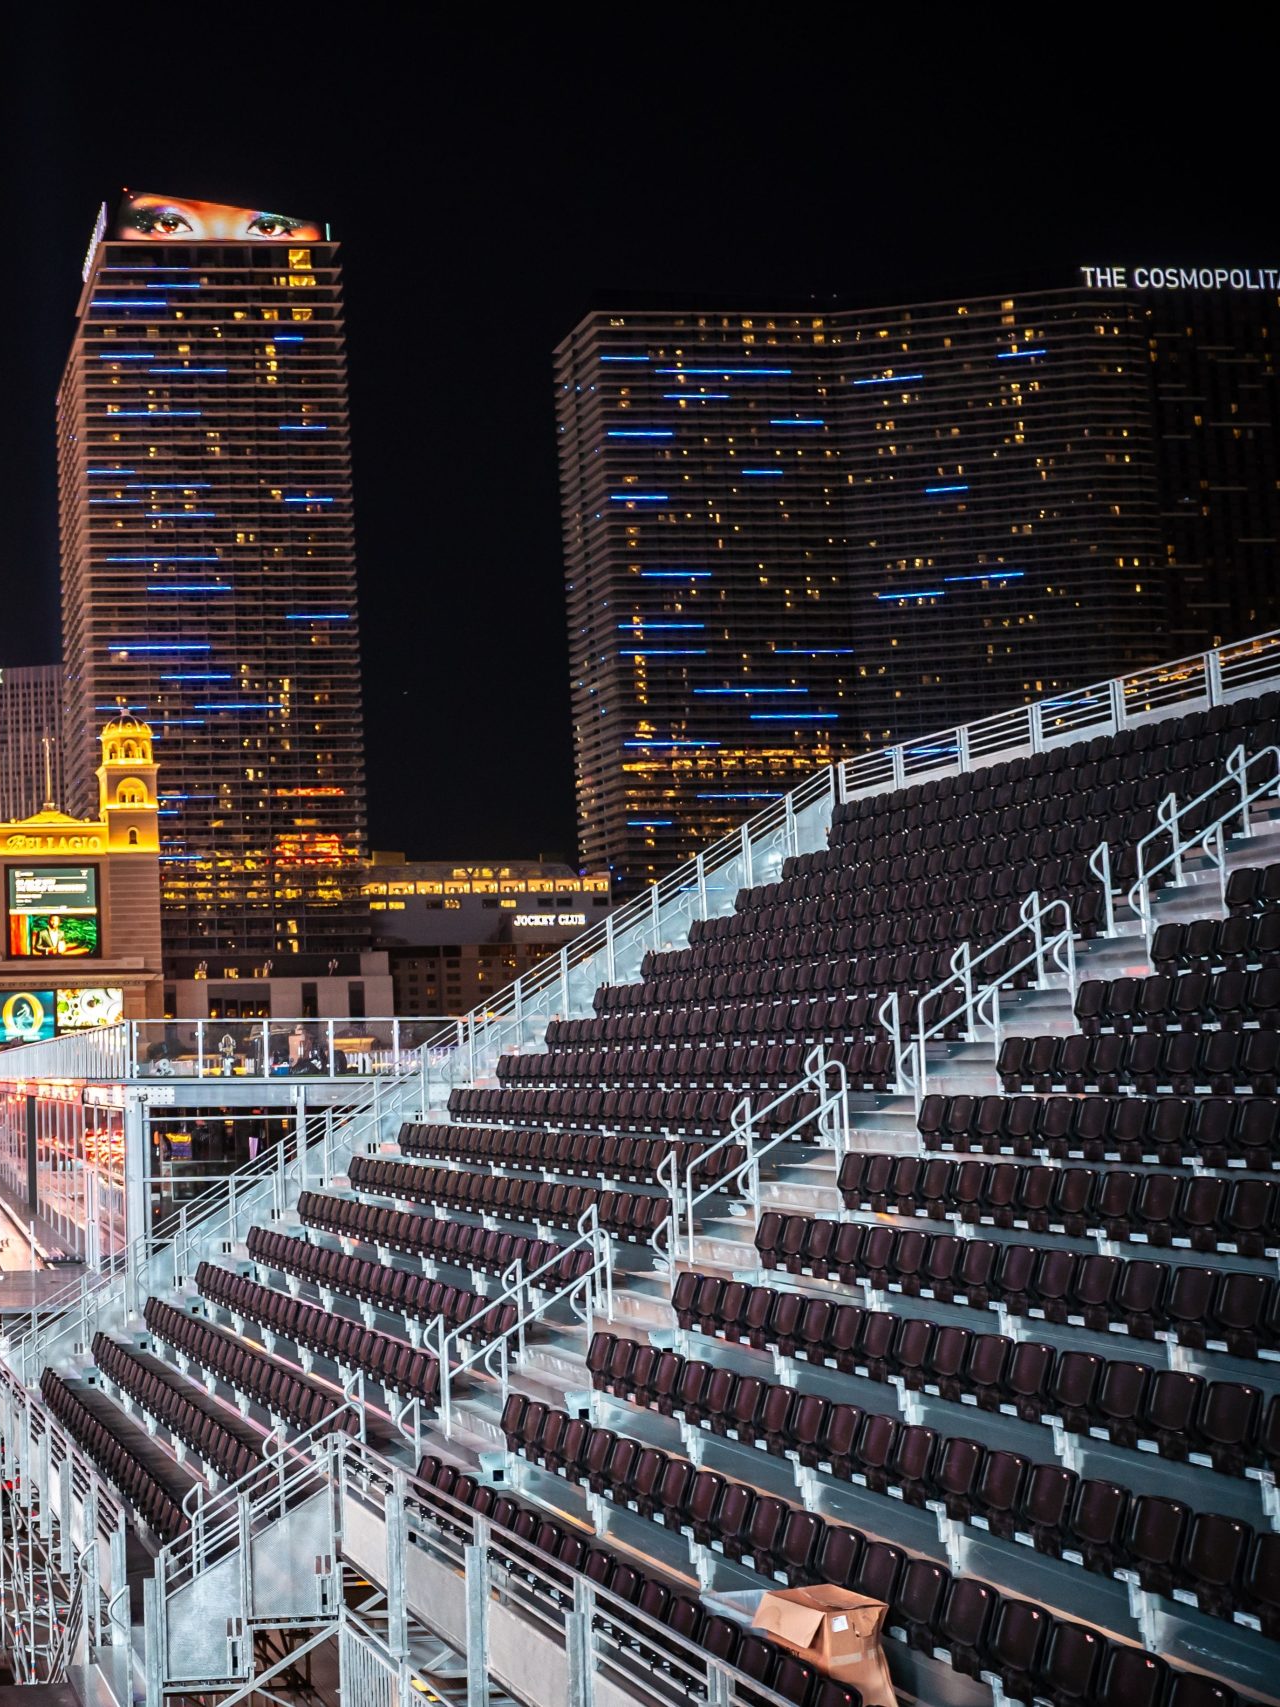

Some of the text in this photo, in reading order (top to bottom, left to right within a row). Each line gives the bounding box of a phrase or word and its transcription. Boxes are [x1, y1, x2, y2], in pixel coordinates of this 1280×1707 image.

[1080, 266, 1127, 288] THE
[514, 913, 586, 927] JOCKEY CLUB
